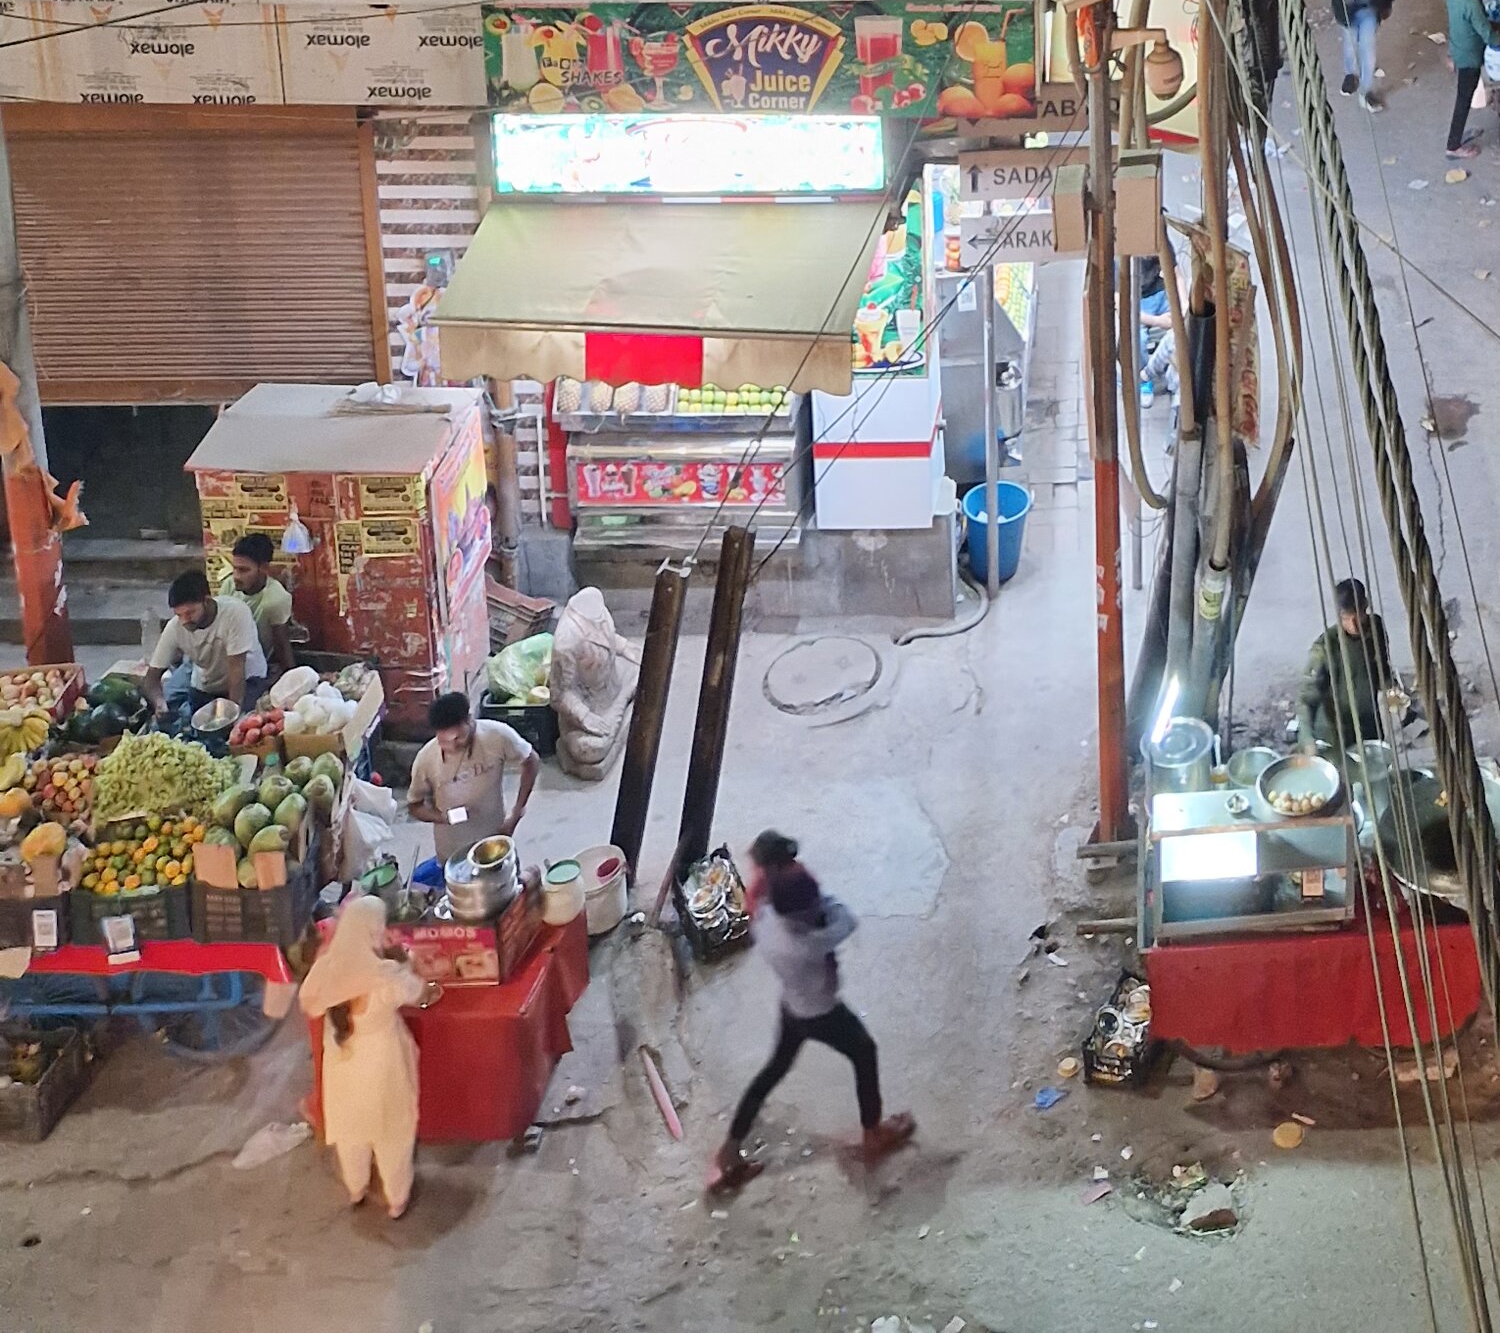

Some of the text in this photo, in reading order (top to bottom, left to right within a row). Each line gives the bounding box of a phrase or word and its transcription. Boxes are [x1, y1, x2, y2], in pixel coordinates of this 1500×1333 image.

[130, 42, 195, 55] alomax
[305, 34, 371, 48] alomax
[418, 35, 484, 49] alomax
[705, 21, 823, 68] Mikky
[560, 70, 623, 85] SHAKES
[750, 70, 812, 93] Juice
[366, 85, 432, 100] alomax
[749, 92, 807, 110] Corner
[1036, 99, 1076, 117] AB
